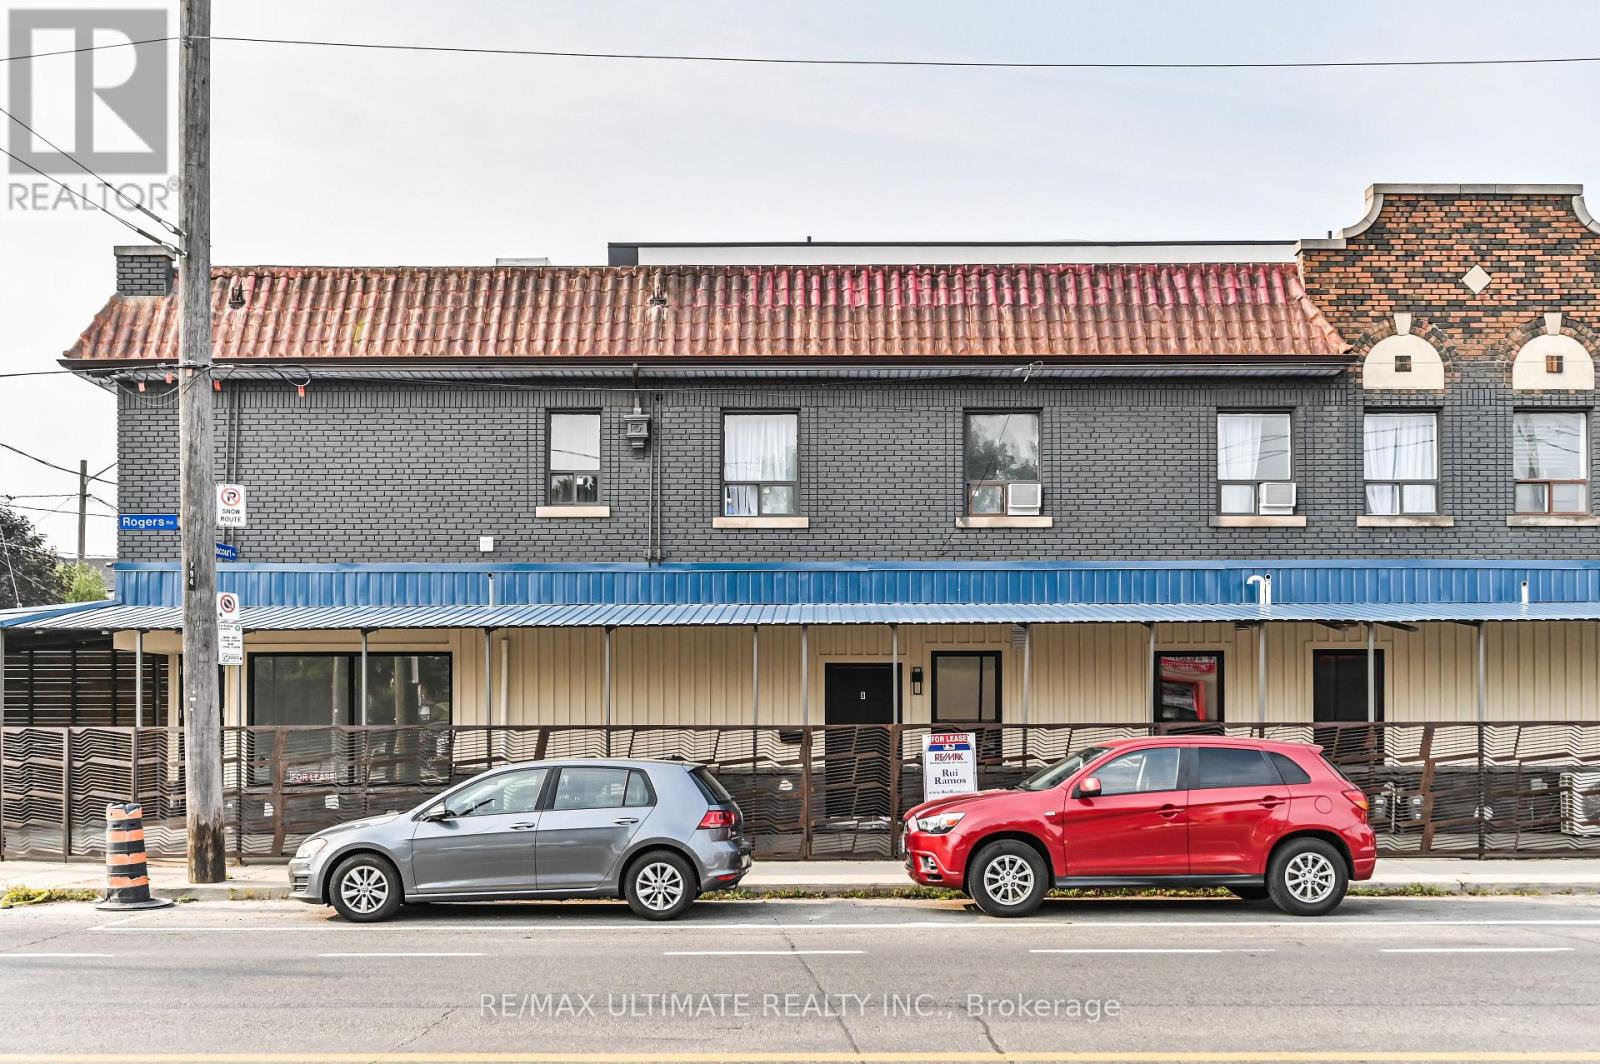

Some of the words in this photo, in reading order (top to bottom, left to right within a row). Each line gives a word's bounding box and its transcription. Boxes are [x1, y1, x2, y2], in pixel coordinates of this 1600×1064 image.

[122, 516, 165, 529] Rogers
[935, 753, 964, 761] RE/MAX
[942, 768, 959, 777] Rui
[291, 773, 308, 781] FOR
[934, 777, 967, 785] Ramos
